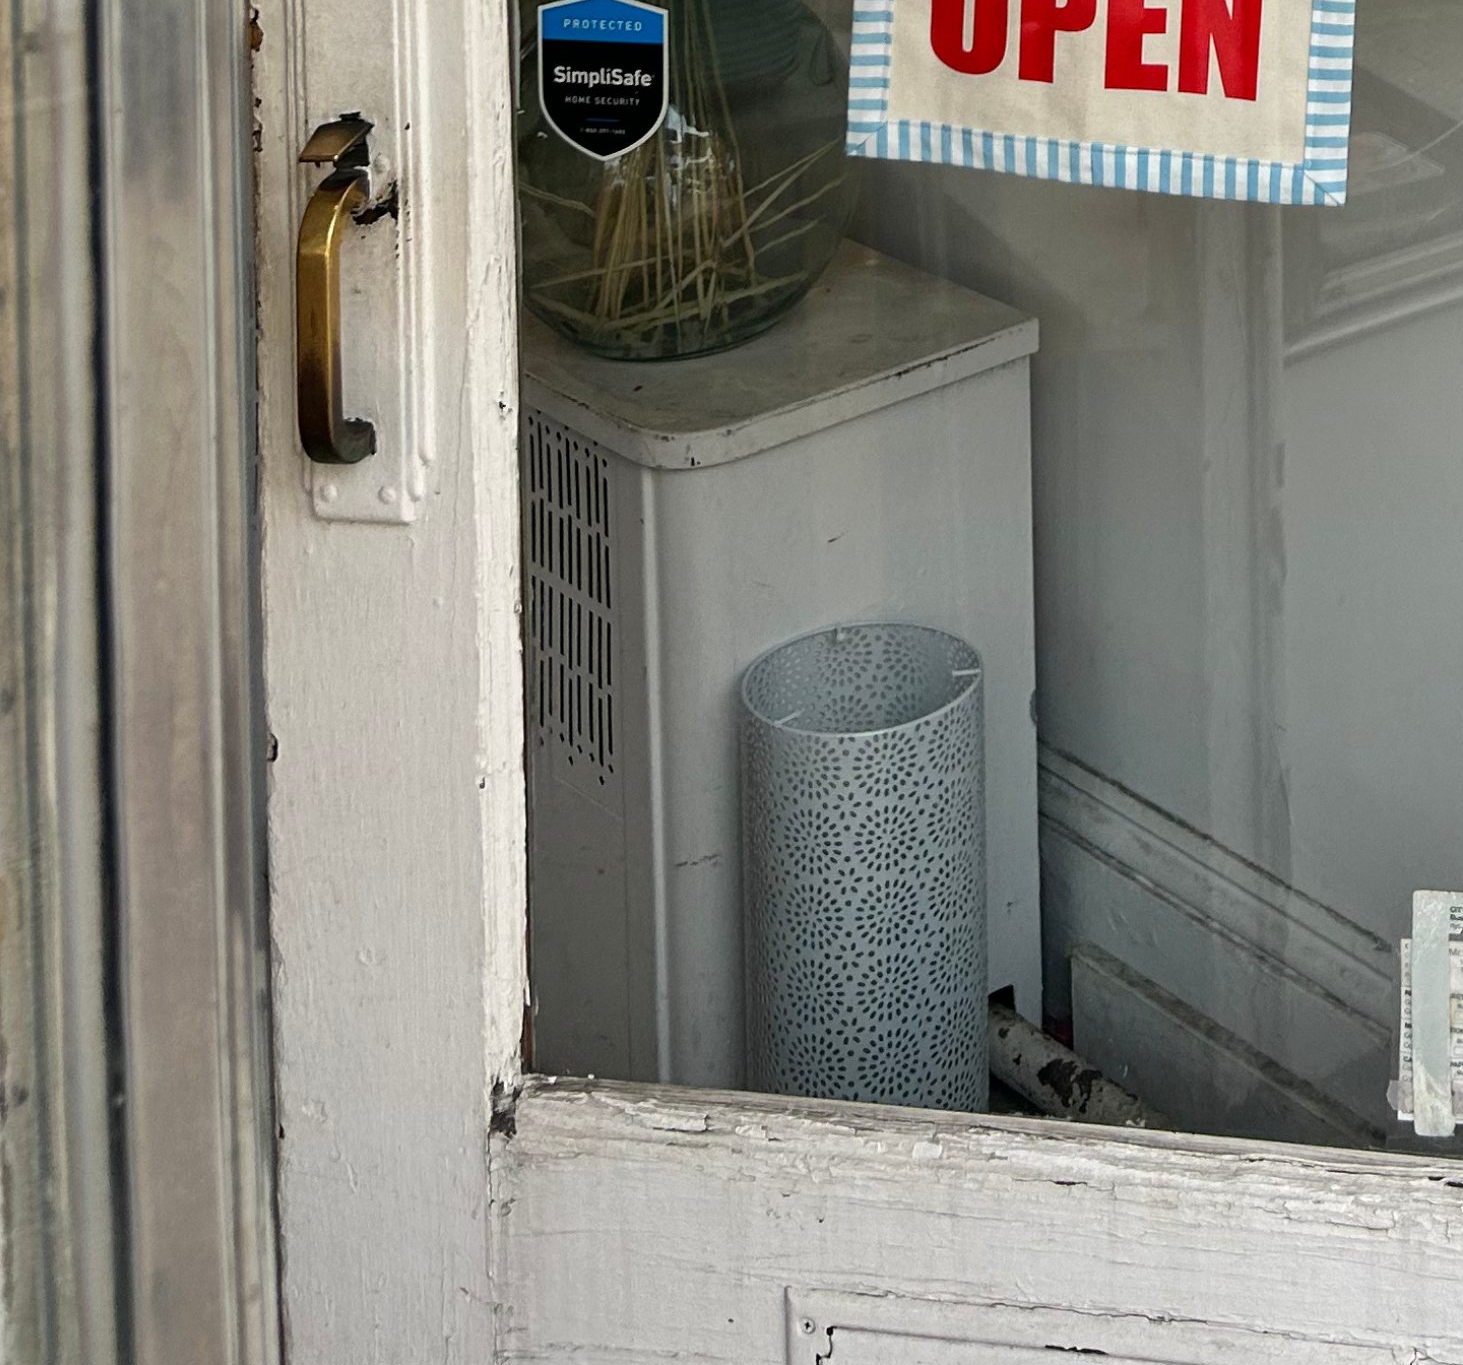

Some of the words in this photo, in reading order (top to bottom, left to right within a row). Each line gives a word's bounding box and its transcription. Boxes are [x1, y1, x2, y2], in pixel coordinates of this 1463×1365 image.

[563, 18, 643, 32] PROTECTED
[553, 65, 653, 88] SimpliSafe
[564, 95, 591, 104] HOME
[594, 96, 640, 106] SECURITY
